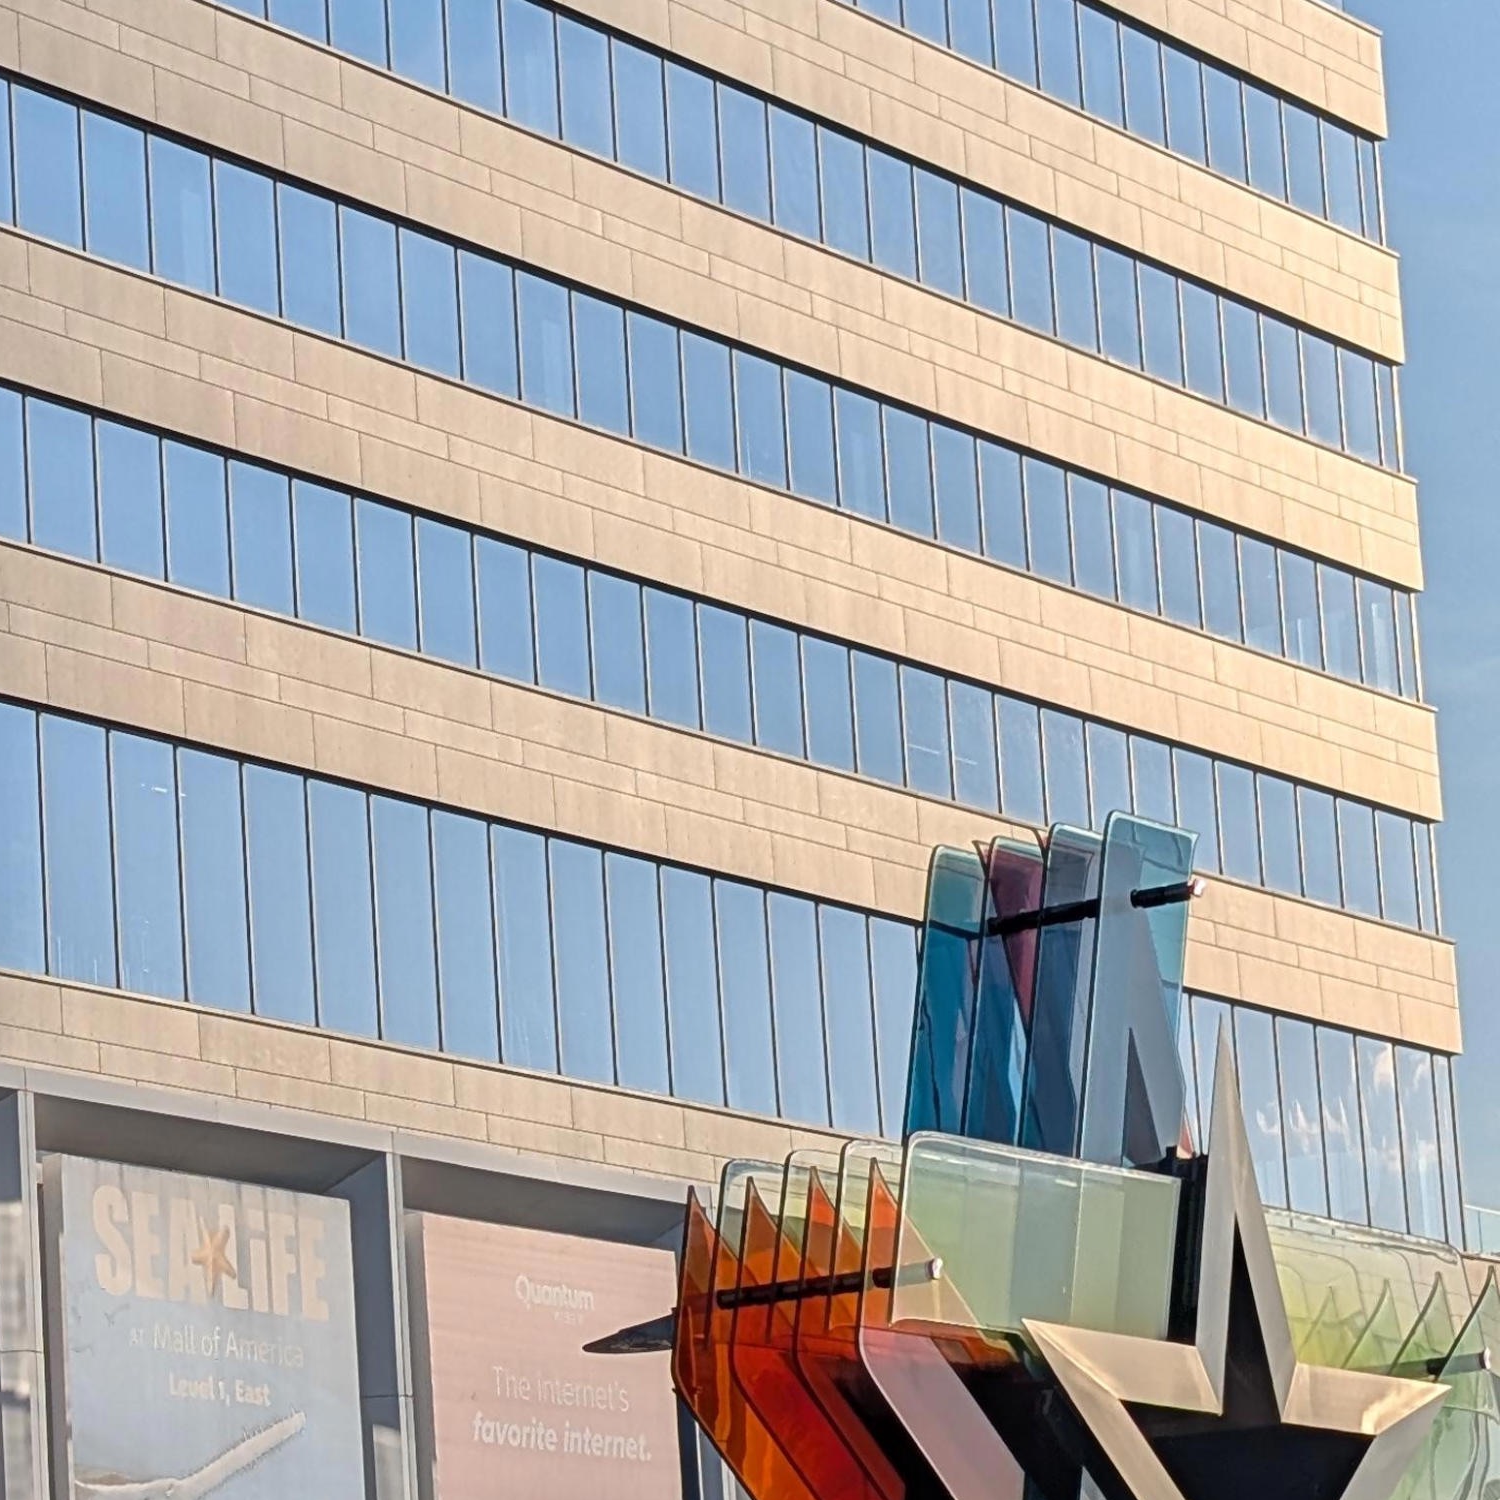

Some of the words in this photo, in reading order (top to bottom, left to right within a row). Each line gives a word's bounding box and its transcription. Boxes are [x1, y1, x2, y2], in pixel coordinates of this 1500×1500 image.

[92, 1184, 208, 1304] SEA
[514, 1273, 595, 1311] Quantum
[153, 1321, 196, 1356] Mall
[201, 1326, 221, 1357] of
[225, 1331, 305, 1369] America
[168, 1372, 215, 1400] Level
[235, 1379, 272, 1407] East
[493, 1366, 531, 1401] The
[473, 1410, 558, 1451] favorite
[563, 1420, 652, 1462] internet.
